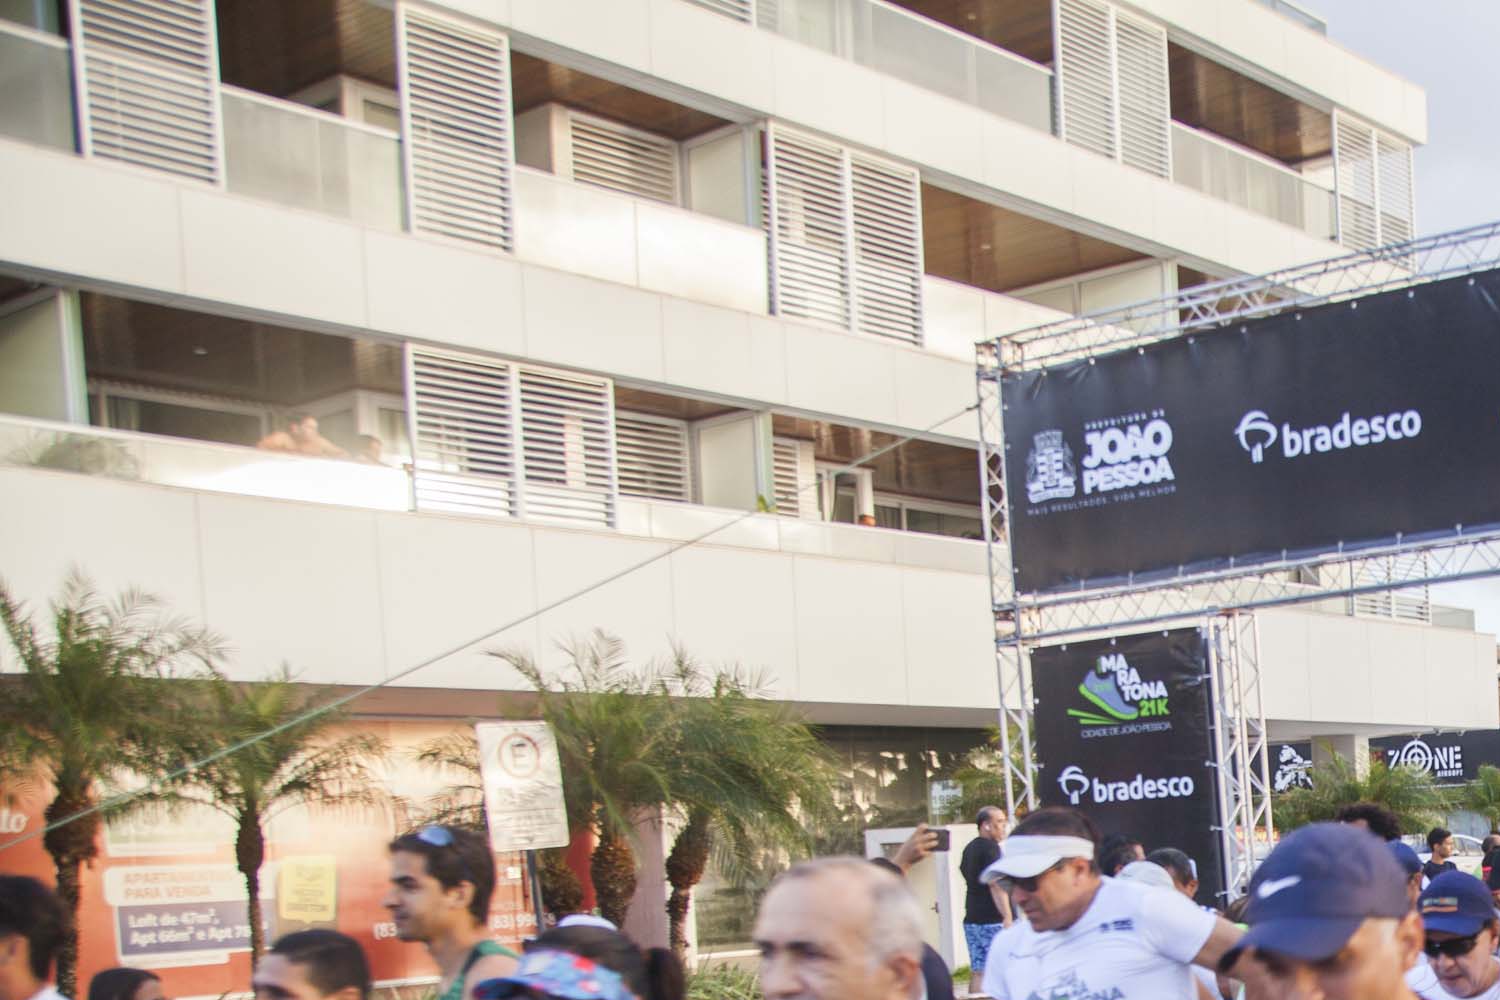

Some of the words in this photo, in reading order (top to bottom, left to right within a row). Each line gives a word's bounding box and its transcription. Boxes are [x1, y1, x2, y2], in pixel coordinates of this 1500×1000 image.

[1281, 409, 1422, 459] bradesco
[1083, 456, 1176, 494] PESSOA
[1388, 740, 1462, 777] ZONE
[1437, 769, 1463, 777] AIRSOFT
[1093, 774, 1194, 802] bradesco
[128, 913, 158, 929] Loft
[160, 914, 179, 927] de
[130, 930, 157, 947] Apt
